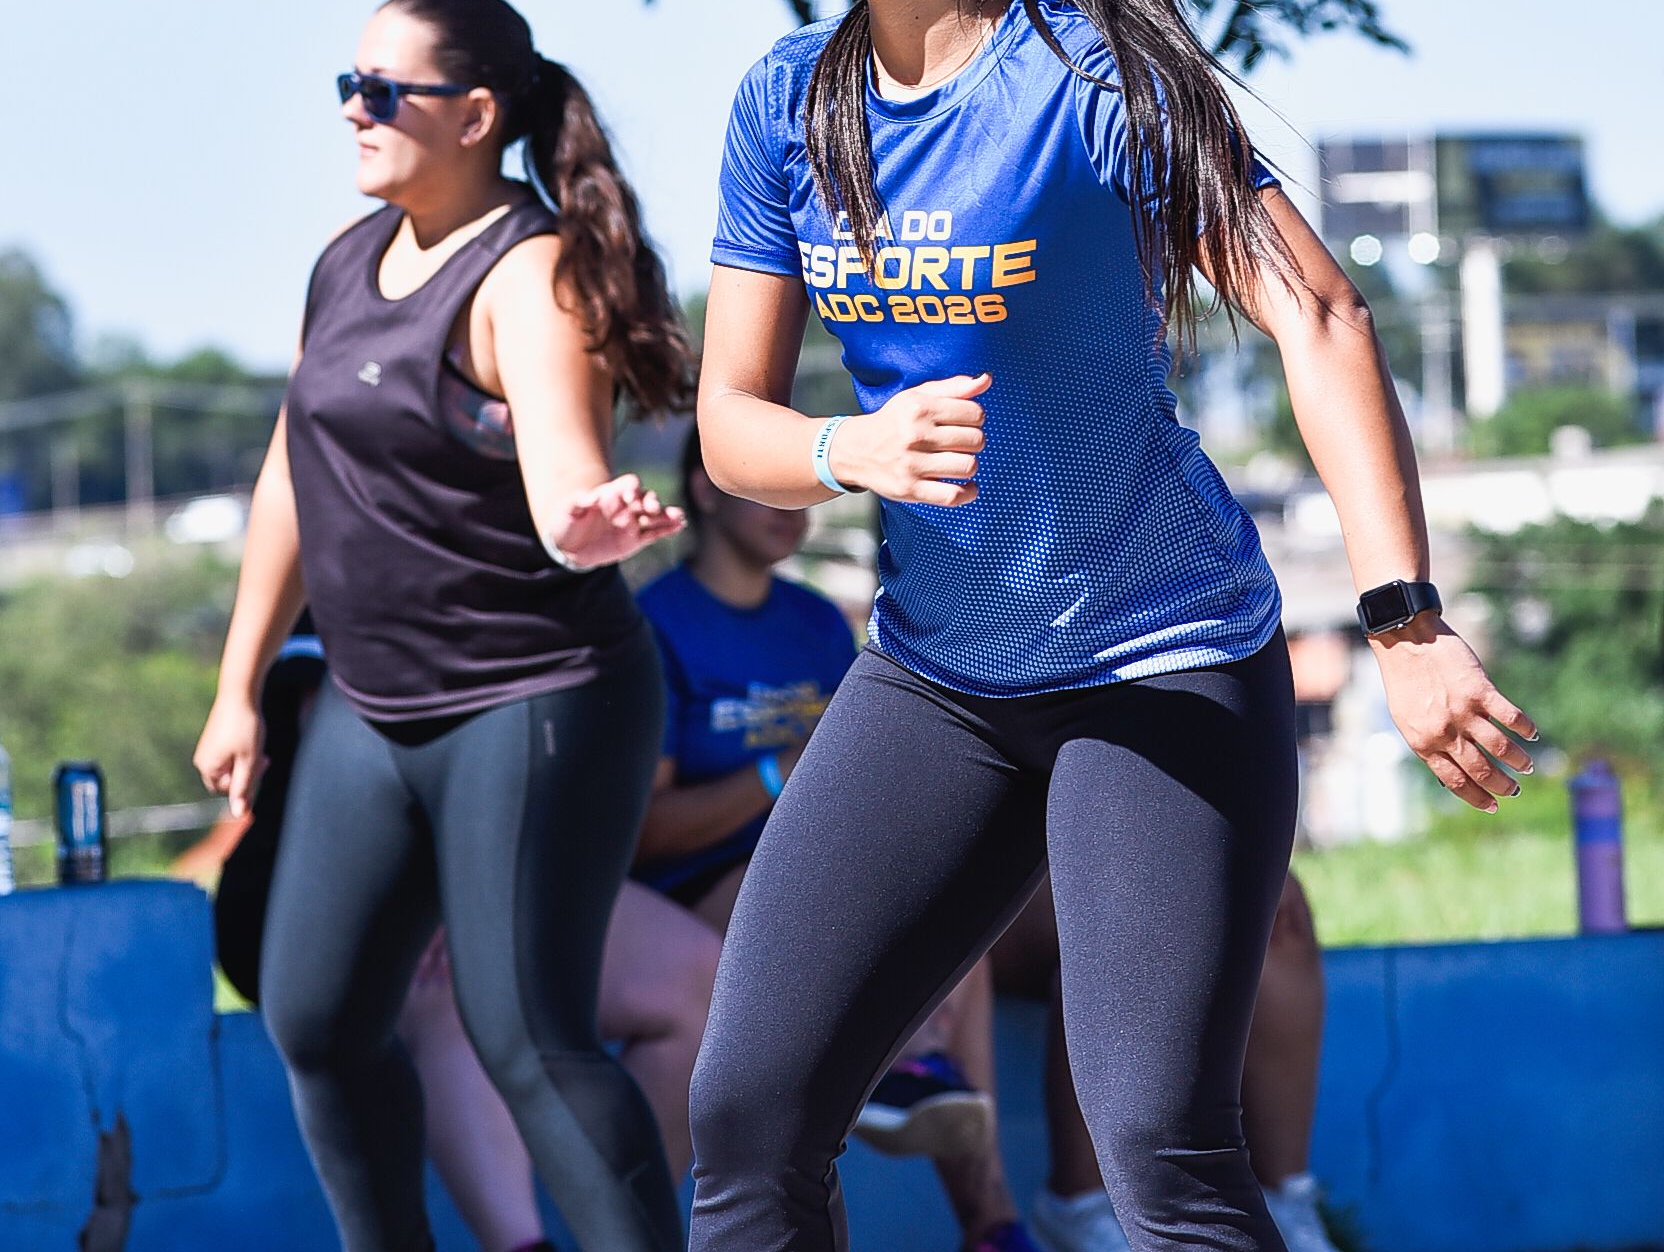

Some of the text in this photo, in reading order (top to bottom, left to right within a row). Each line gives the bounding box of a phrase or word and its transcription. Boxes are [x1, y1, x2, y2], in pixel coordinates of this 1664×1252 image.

[901, 210, 952, 241] DO
[815, 293, 1008, 324] ADC 2026
